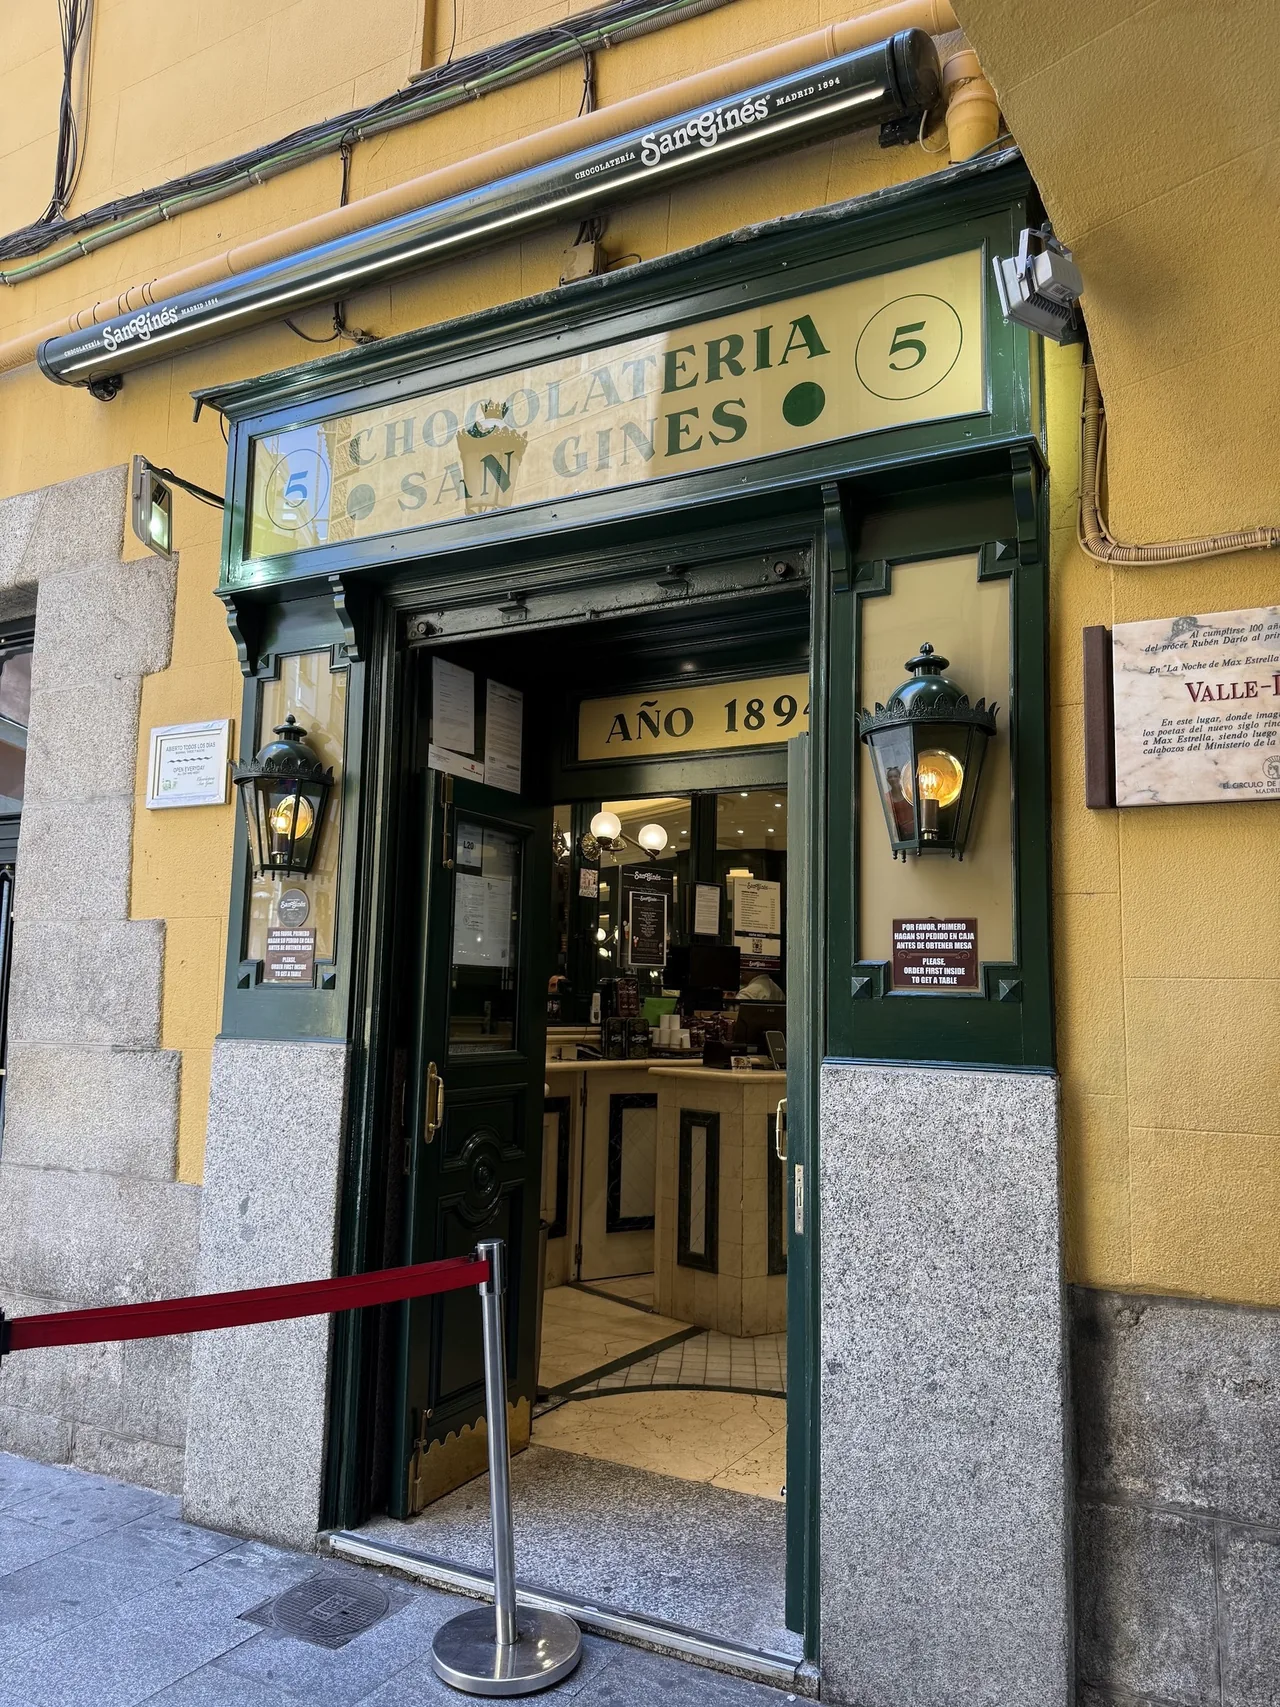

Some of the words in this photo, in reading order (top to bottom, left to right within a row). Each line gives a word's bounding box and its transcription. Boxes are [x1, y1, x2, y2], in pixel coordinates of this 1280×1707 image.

[575, 152, 636, 181] CHOCOLATERÍA
[776, 87, 815, 107] MADRID
[818, 76, 841, 92] 1894
[181, 303, 204, 316] MADRID
[889, 320, 928, 371] 5
[350, 313, 831, 467] CHOCOLATERIA
[397, 450, 515, 512] SAN
[552, 397, 748, 479] GINES
[284, 470, 309, 508] 5
[1189, 630, 1199, 639] Al
[1203, 626, 1245, 638] cumplirse
[1249, 623, 1264, 633] 100
[1267, 622, 1280, 630] añ
[1144, 644, 1158, 653] del
[1161, 641, 1188, 652] prócer
[1192, 638, 1219, 648] Rubén
[1223, 635, 1248, 645] Darío
[1252, 632, 1261, 641] al
[1149, 666, 1161, 674] En
[1181, 661, 1207, 671] Noche
[1208, 660, 1219, 668] de
[1222, 658, 1242, 667] Max
[605, 700, 694, 744] AÑO
[724, 694, 809, 733] 189
[1161, 718, 1173, 727] En
[1176, 718, 1193, 726] este
[1196, 716, 1222, 725] lugar,
[1225, 713, 1252, 722] donde
[1256, 711, 1280, 720] imag
[1142, 729, 1155, 737] los
[1157, 728, 1185, 738] poetas
[1189, 725, 1203, 734] del
[1207, 724, 1233, 732] nuevo
[1237, 720, 1260, 730] siglo
[1153, 737, 1173, 745] Max
[1176, 734, 1214, 744] Estrella,
[1218, 731, 1248, 740] siendo
[1252, 730, 1277, 739] luego
[1142, 744, 1185, 755] calabozos
[1187, 743, 1201, 752] del
[1204, 740, 1250, 751] Ministerio
[1253, 739, 1265, 747] de
[1266, 738, 1276, 746] la
[902, 923, 914, 931] POR
[916, 923, 937, 931] FAVOR,
[938, 923, 966, 931] PRIMERO
[894, 932, 915, 940] HAGAN
[916, 932, 924, 940] SU
[926, 932, 948, 940] PEDIDO
[949, 932, 957, 940] EN
[958, 932, 974, 940] CAJA
[903, 967, 924, 975] ORDER
[925, 967, 943, 975] FIRST
[944, 967, 965, 975] INSIDE
[912, 976, 919, 984] TO
[921, 976, 932, 984] GET
[933, 976, 939, 984] A
[939, 976, 957, 984] TABLE
